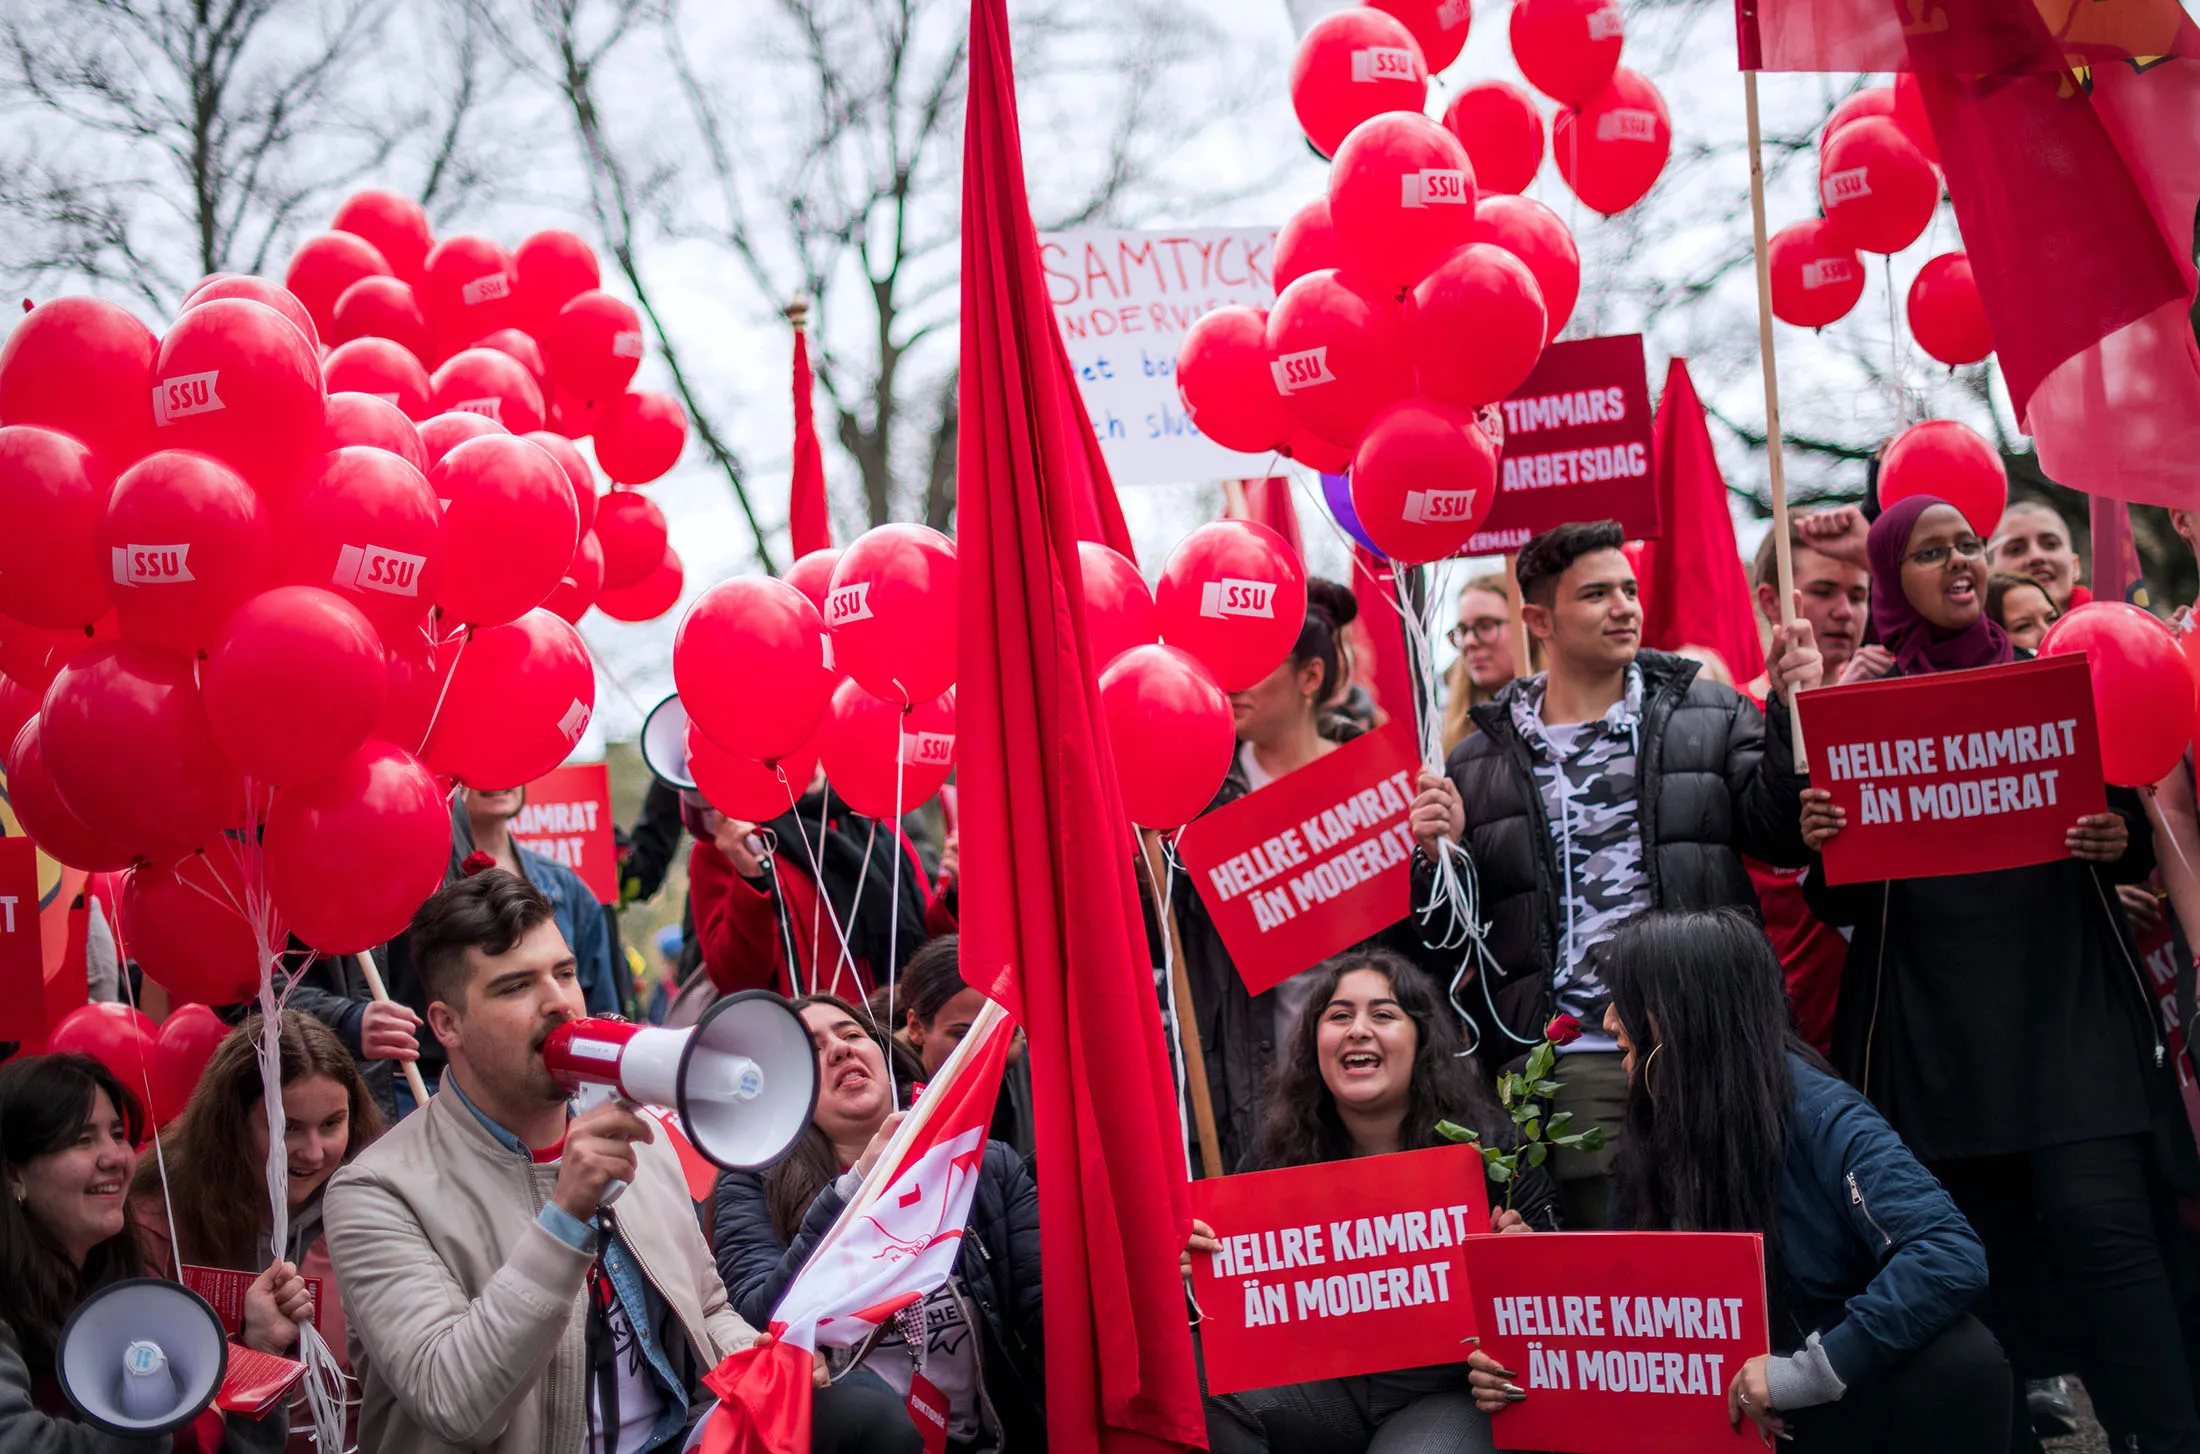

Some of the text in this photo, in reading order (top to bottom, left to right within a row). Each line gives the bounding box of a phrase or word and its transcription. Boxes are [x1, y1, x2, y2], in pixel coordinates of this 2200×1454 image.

[1376, 53, 1408, 73] SSU
[1427, 175, 1460, 197] SSU
[1041, 233, 1278, 306] SAMTYCK
[1074, 353, 1116, 381] et
[1285, 355, 1322, 384] SSU
[169, 379, 209, 411] SSU
[1503, 386, 1625, 434] TIMMARS
[1429, 496, 1468, 517] SSU
[134, 551, 179, 577] SSU
[367, 555, 415, 588] SSU
[833, 590, 861, 619] SSU
[1227, 585, 1266, 611] SSU
[920, 739, 950, 760] SSU
[1827, 718, 2077, 781] HELLRE KAMRAT
[1859, 769, 2059, 825] ÄN MODERAT
[1208, 769, 1416, 903] HELLRE KAMRAT
[1247, 820, 1416, 933] ÄN MODERAT
[1211, 1204, 1468, 1279] HELLRE KAMRAT
[1243, 1261, 1451, 1328] ÄN MODERAT
[1493, 1295, 1743, 1340] HELLRE KAMRAT
[1527, 1341, 1724, 1396] ÄN MODERAT
